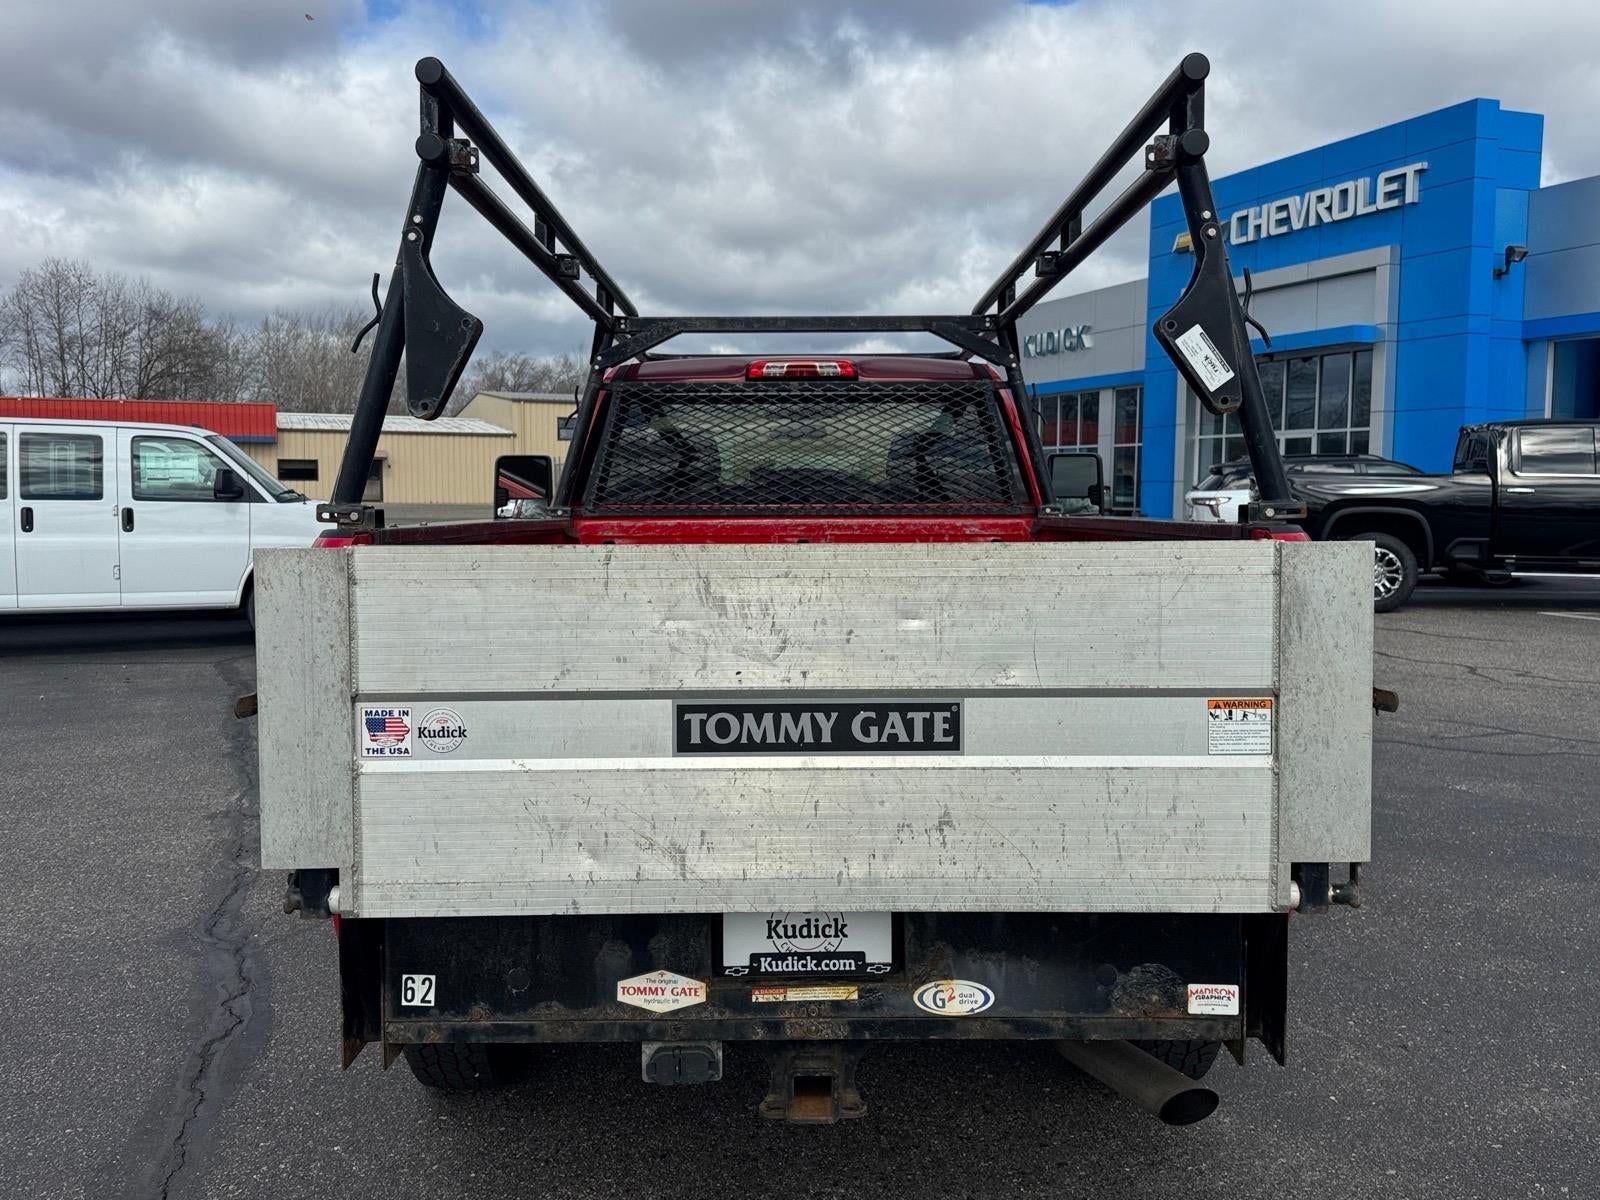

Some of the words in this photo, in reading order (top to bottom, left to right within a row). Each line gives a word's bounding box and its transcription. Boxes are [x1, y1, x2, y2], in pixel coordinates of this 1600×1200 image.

[1230, 161, 1428, 246] CHEVROLET
[1023, 324, 1092, 358] KUDICK
[364, 709, 395, 717] MADE
[398, 709, 410, 717] IN
[417, 726, 467, 739] Kudick
[683, 712, 838, 744] TOMMY
[851, 711, 954, 743] GATE
[365, 747, 386, 755] THE
[389, 747, 410, 755] USA
[426, 739, 459, 751] CHEVROLET
[766, 918, 848, 939] Kudick
[759, 956, 856, 972] Kudick.com
[658, 978, 678, 986] original
[403, 976, 433, 1004] 62
[620, 986, 667, 997] TOMMY
[671, 986, 700, 997] GATE
[1189, 987, 1236, 998] MADISON
[1195, 994, 1232, 1002] GRAPHICS
